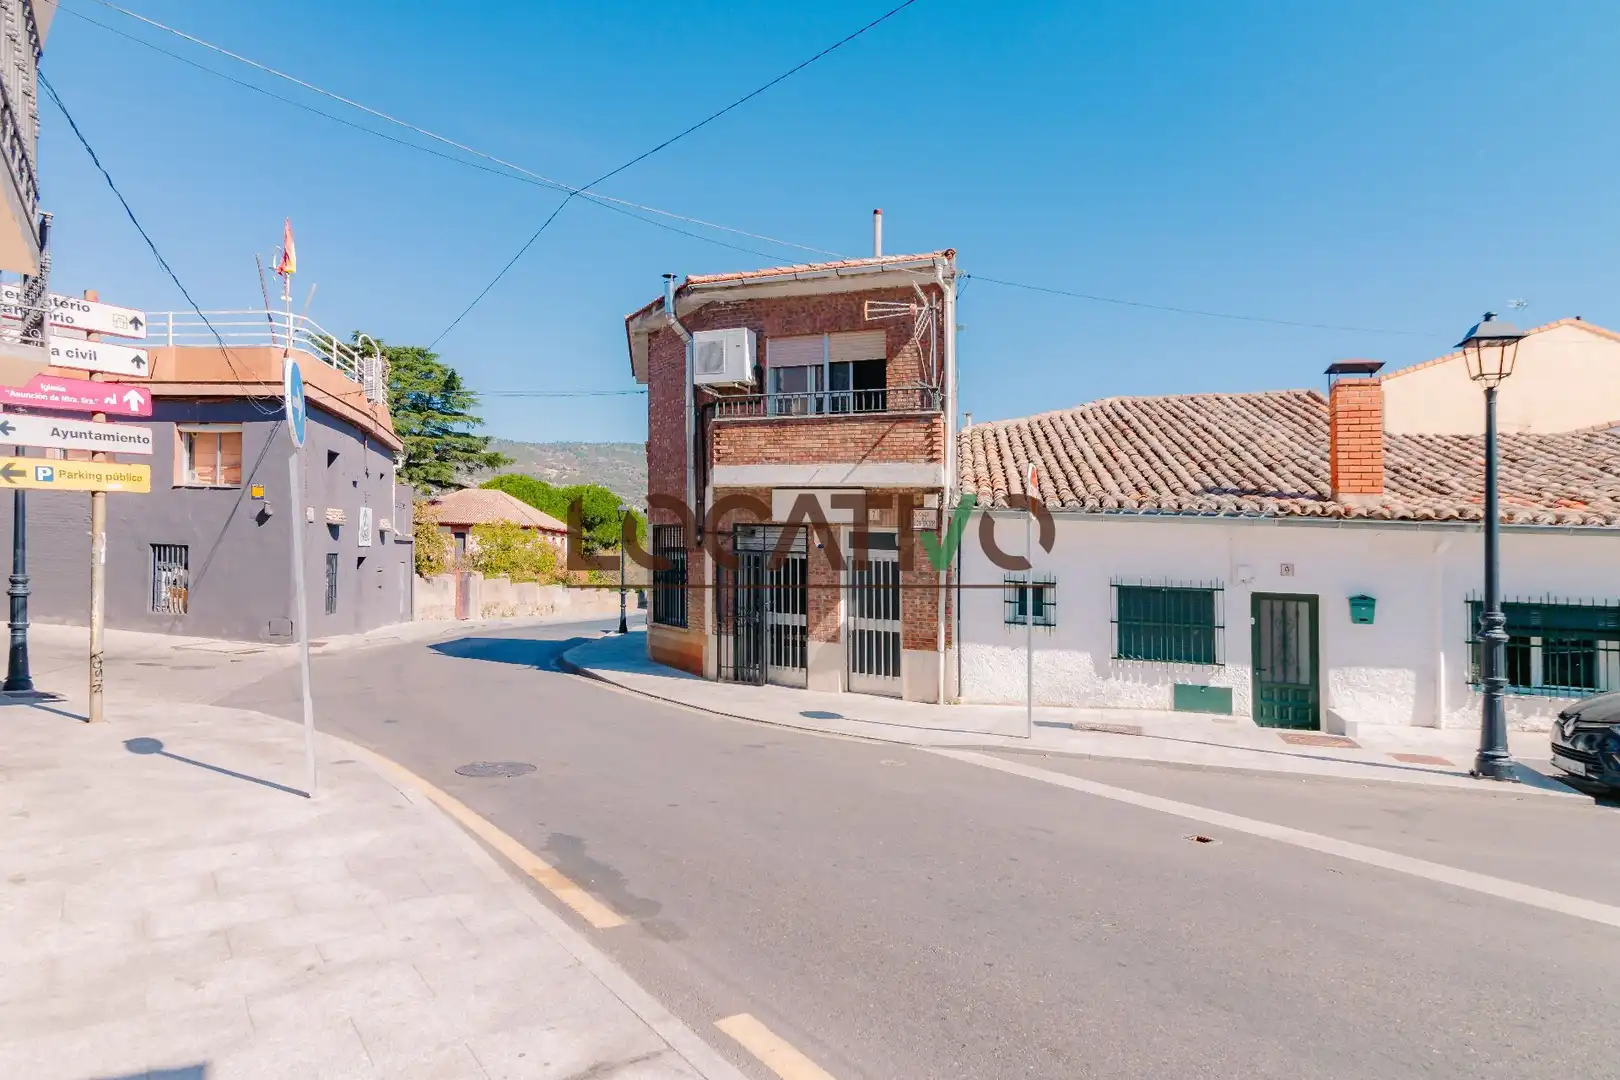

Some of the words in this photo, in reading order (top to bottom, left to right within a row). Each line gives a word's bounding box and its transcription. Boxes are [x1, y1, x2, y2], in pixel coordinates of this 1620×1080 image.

[65, 348, 97, 361] civil
[50, 427, 150, 445] Ayuntamiento
[37, 467, 52, 481] P
[58, 469, 103, 483] Parking
[105, 471, 143, 483] público
